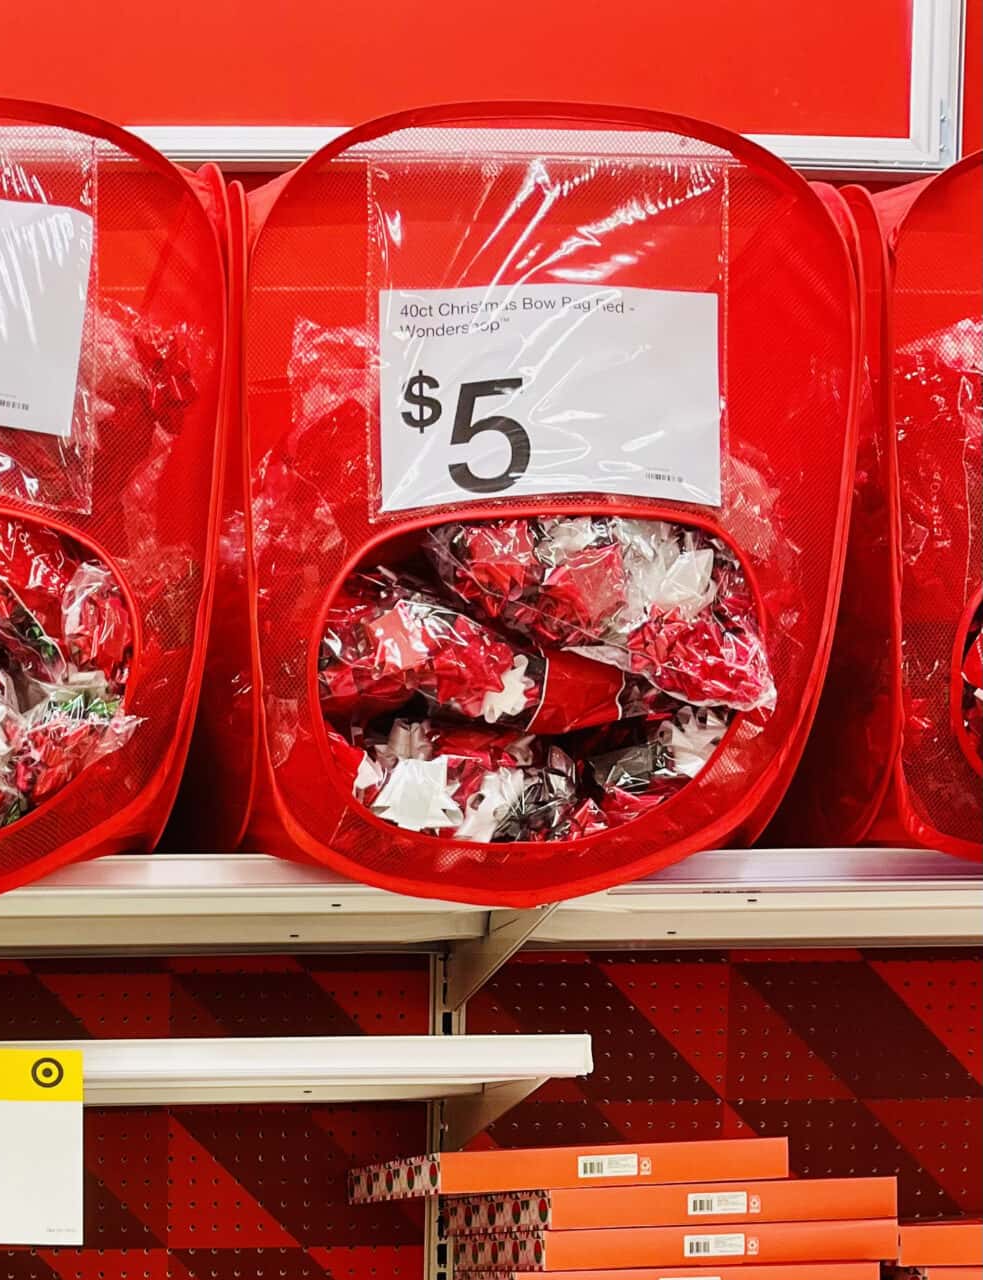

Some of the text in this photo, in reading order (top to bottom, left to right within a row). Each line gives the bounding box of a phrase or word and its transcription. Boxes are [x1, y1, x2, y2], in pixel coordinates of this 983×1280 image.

[400, 304, 433, 318] 40ct
[438, 299, 517, 317] Chrisms
[522, 297, 556, 310] Bow
